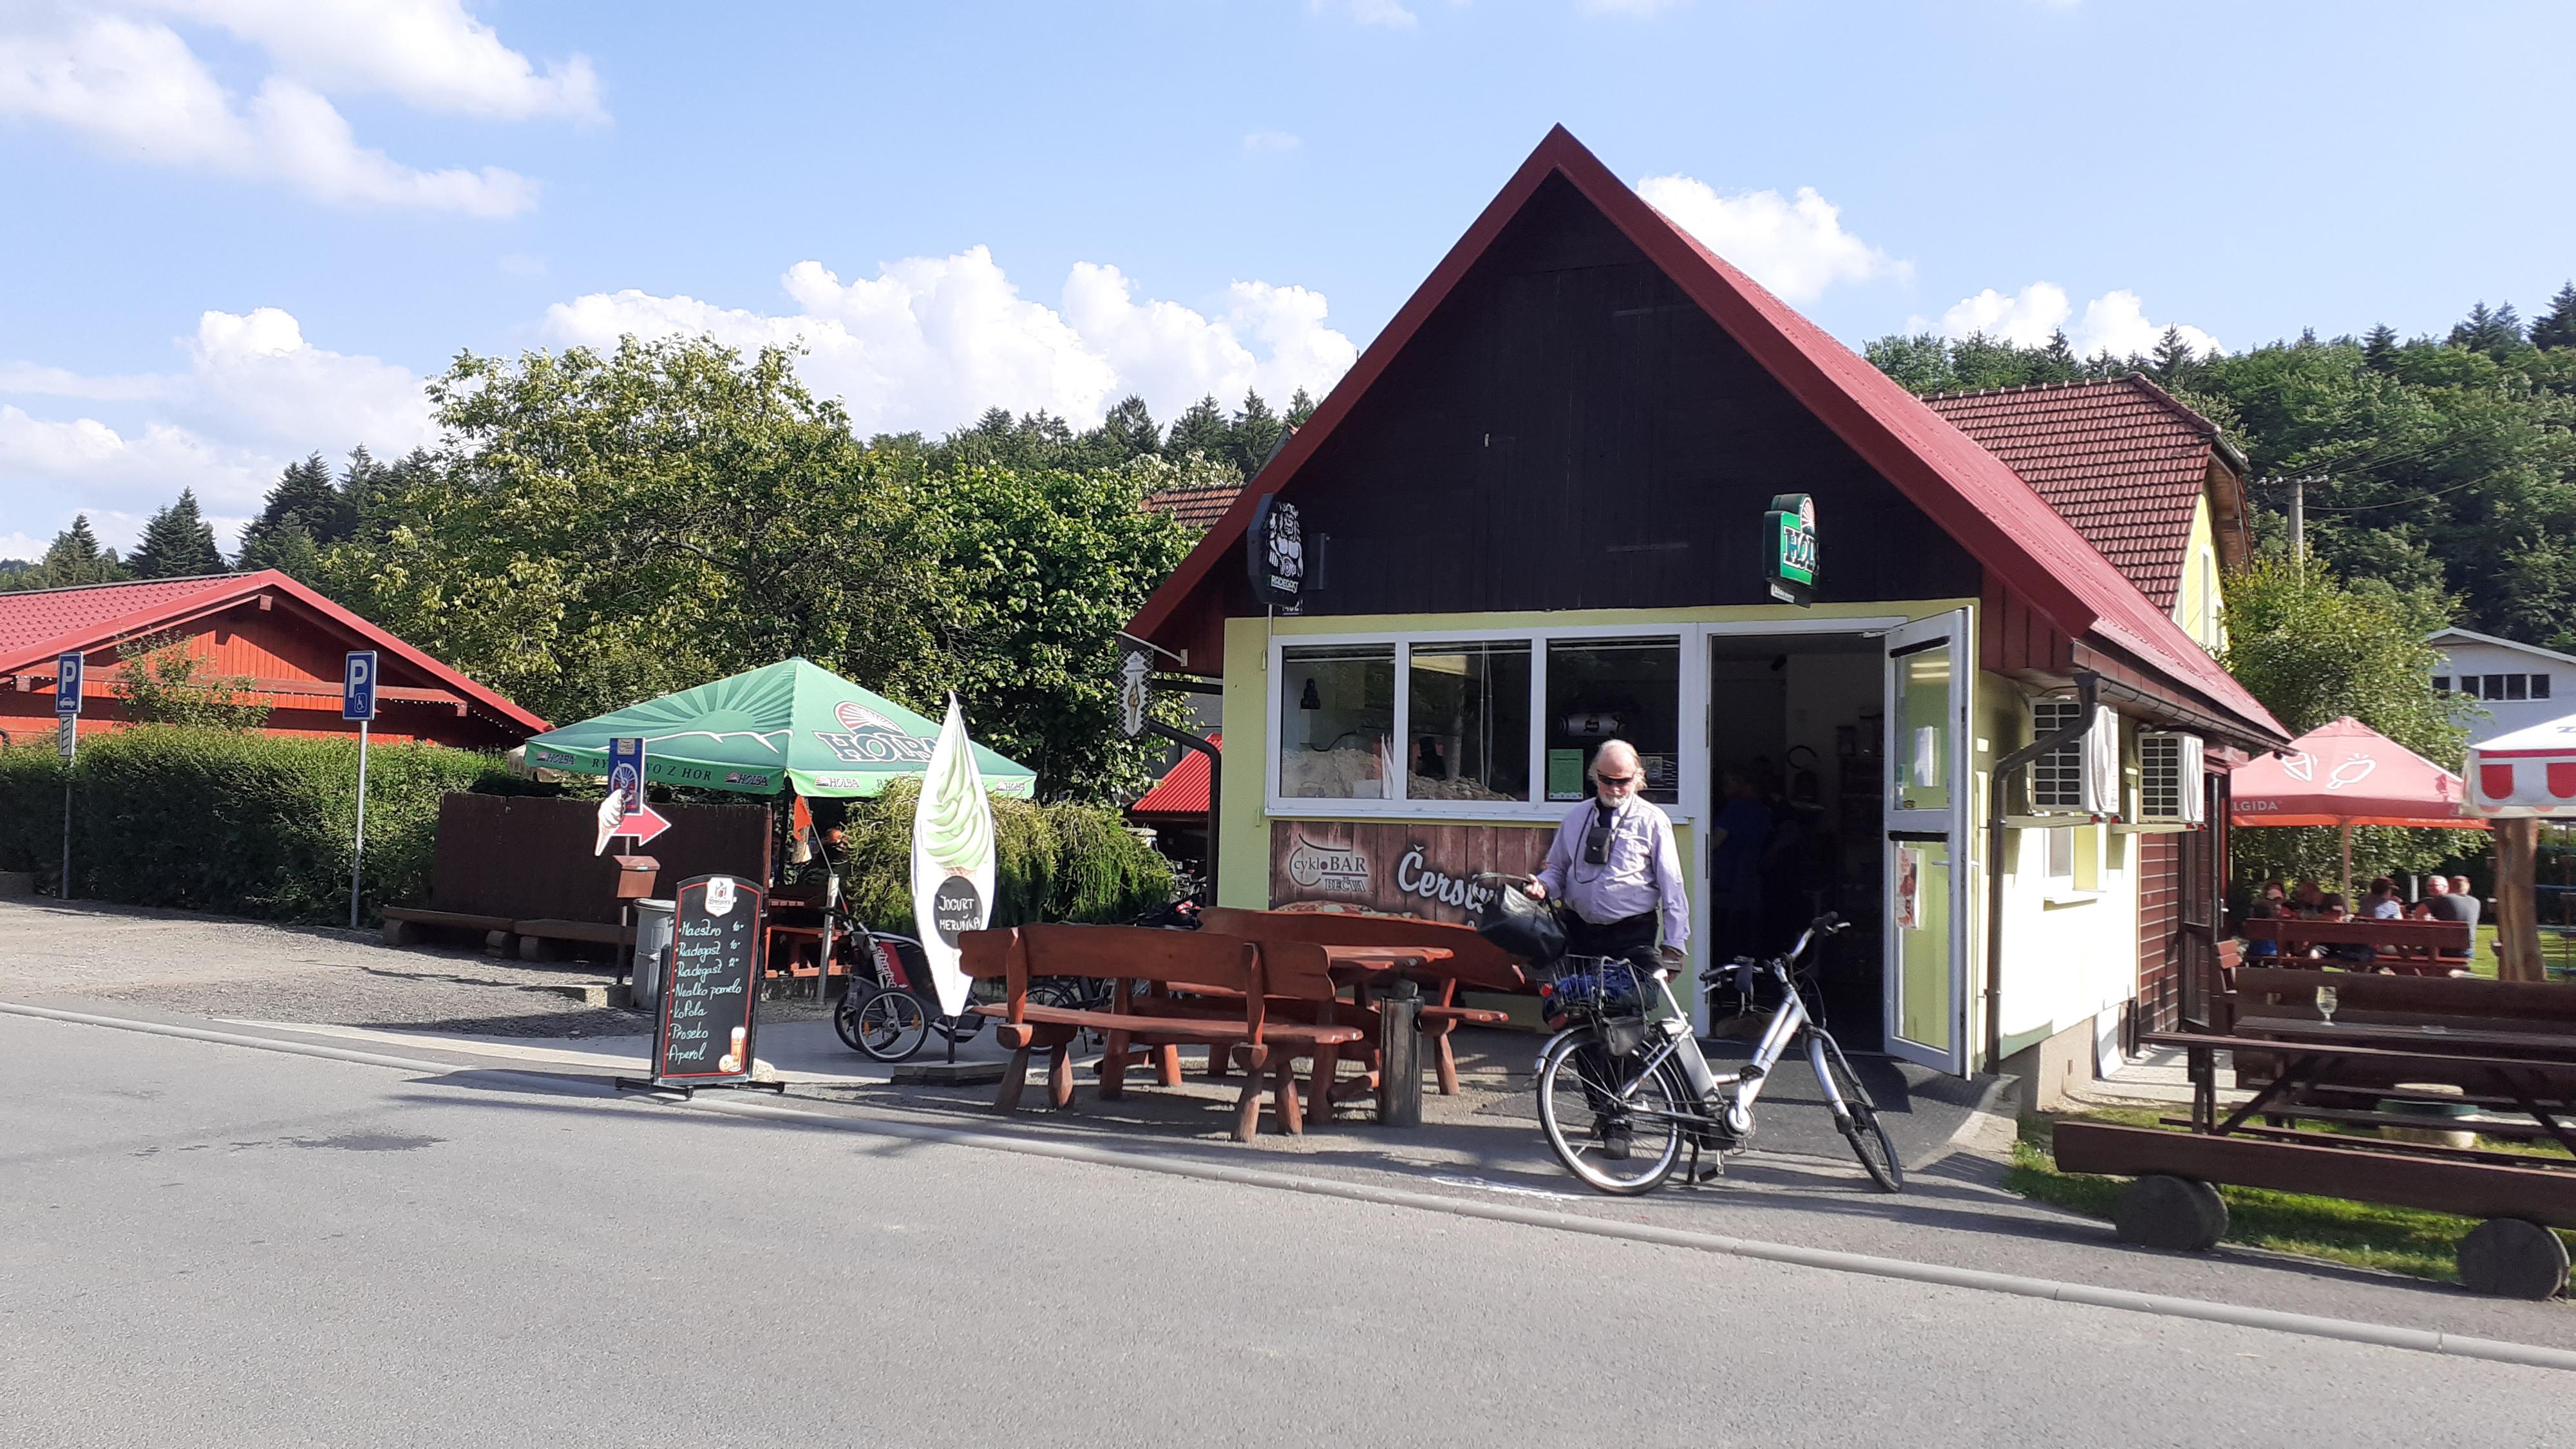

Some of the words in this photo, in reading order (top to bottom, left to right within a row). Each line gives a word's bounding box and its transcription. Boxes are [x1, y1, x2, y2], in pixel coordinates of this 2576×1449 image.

[61, 661, 76, 694] P
[348, 659, 368, 698] P
[547, 753, 574, 765] HOLBA
[667, 766, 676, 776] Z
[681, 768, 712, 781] HOR
[737, 773, 768, 787] HOLBA
[829, 778, 860, 788] HOLBA
[2233, 800, 2279, 812] LGIDA
[1325, 876, 1366, 893] BEČVA
[938, 895, 974, 911] JOGURT
[677, 941, 721, 963] Radegast
[676, 959, 723, 982] Radegast
[675, 982, 708, 997] Nealko
[670, 1021, 708, 1039] Proseko
[668, 1042, 707, 1065] Aperol
